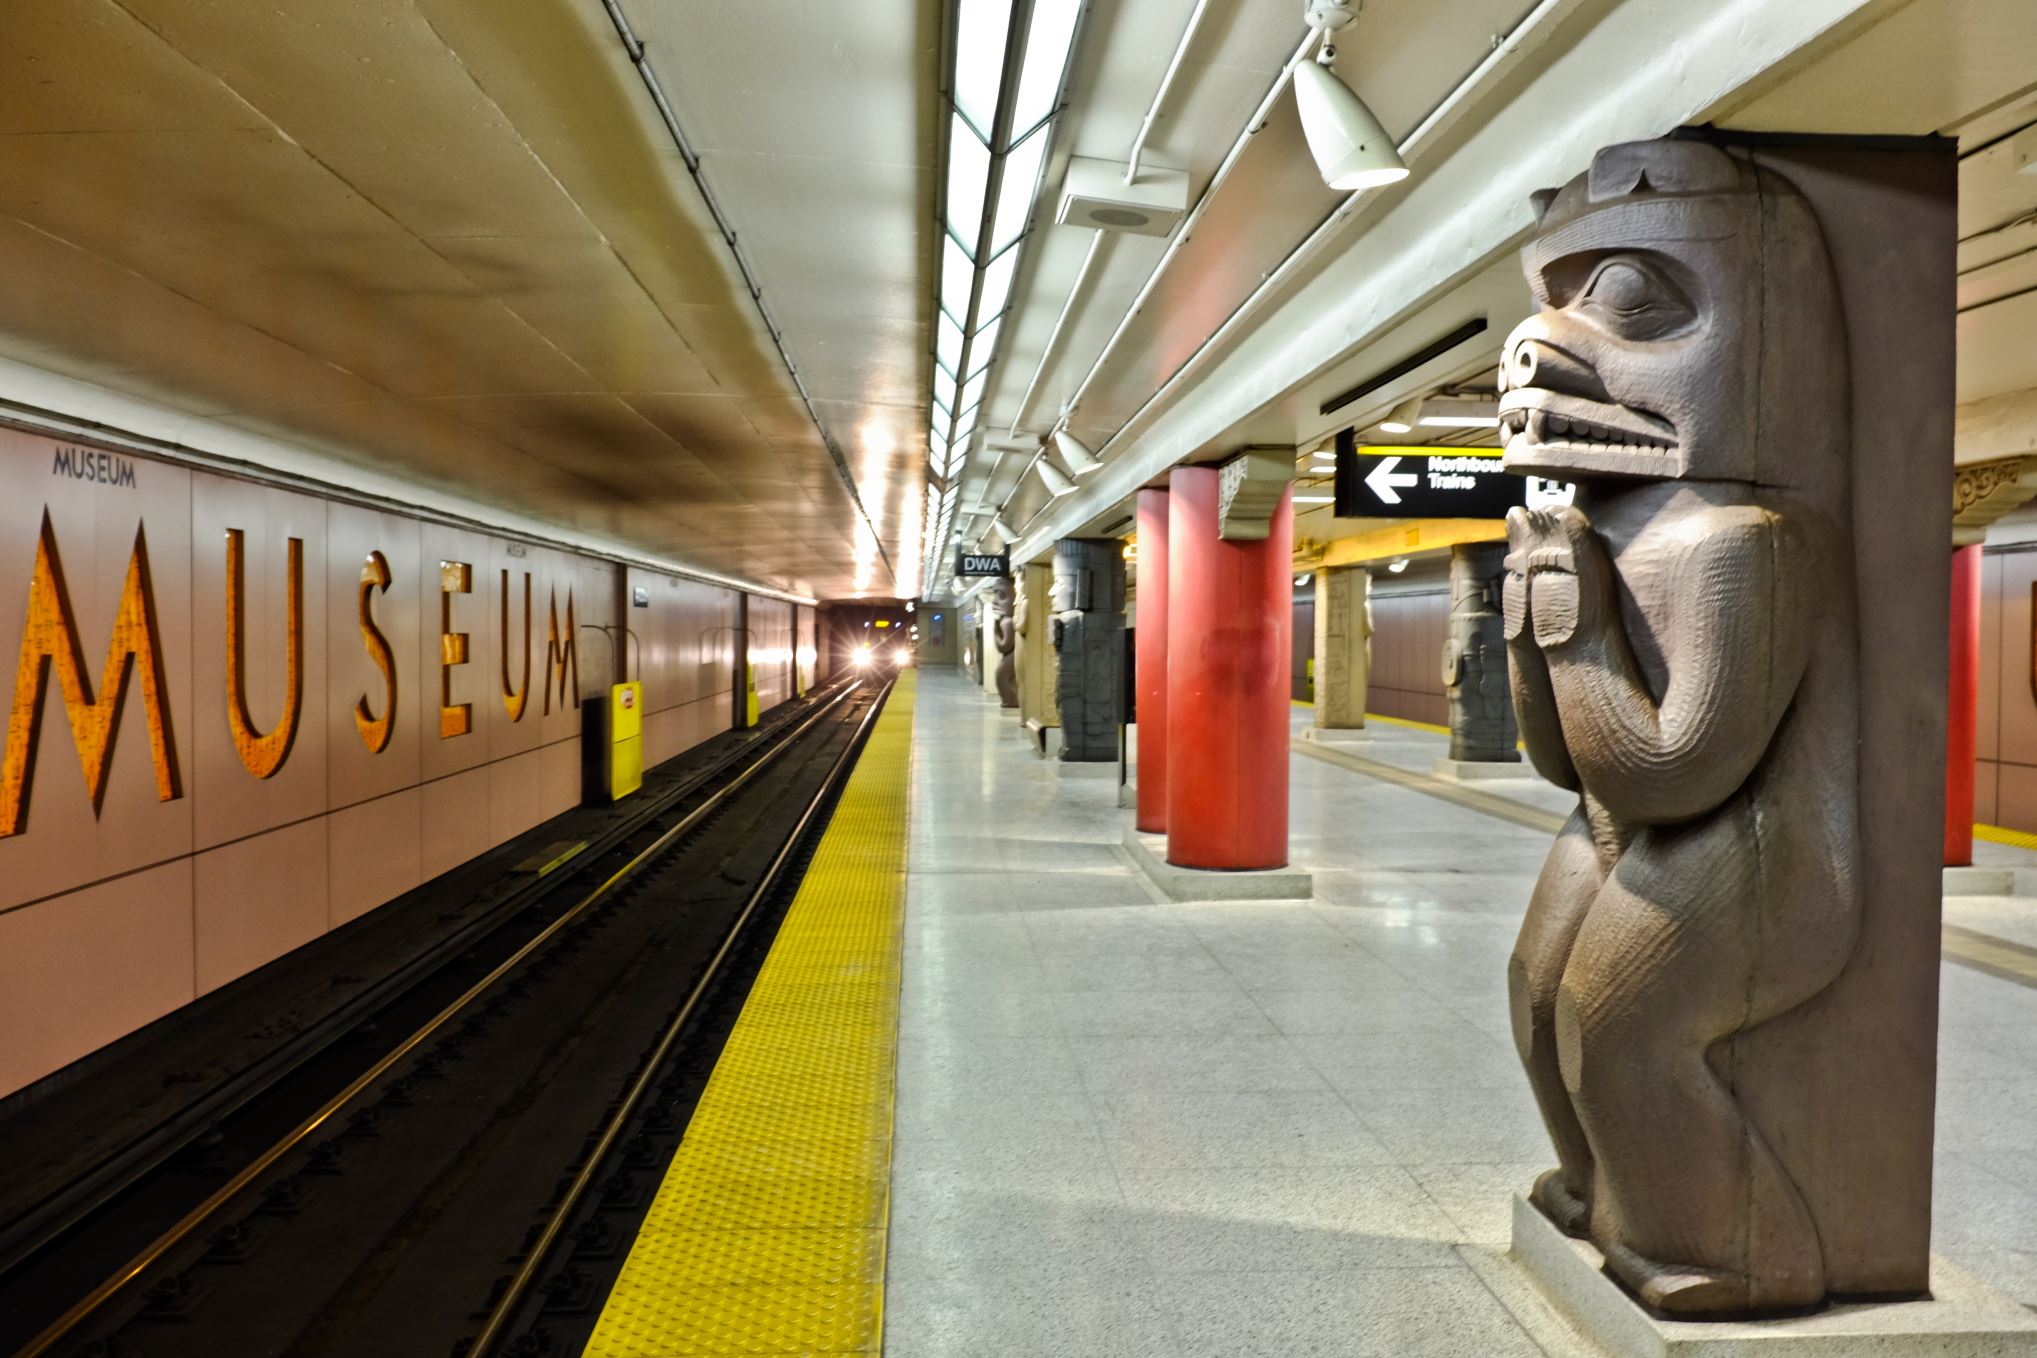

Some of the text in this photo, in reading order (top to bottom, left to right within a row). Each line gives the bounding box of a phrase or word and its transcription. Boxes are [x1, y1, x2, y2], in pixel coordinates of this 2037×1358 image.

[52, 446, 136, 489] MUSEUM
[1427, 473, 1476, 489] Trains
[964, 557, 1001, 571] DWA
[0, 502, 580, 840] MUSEUM
